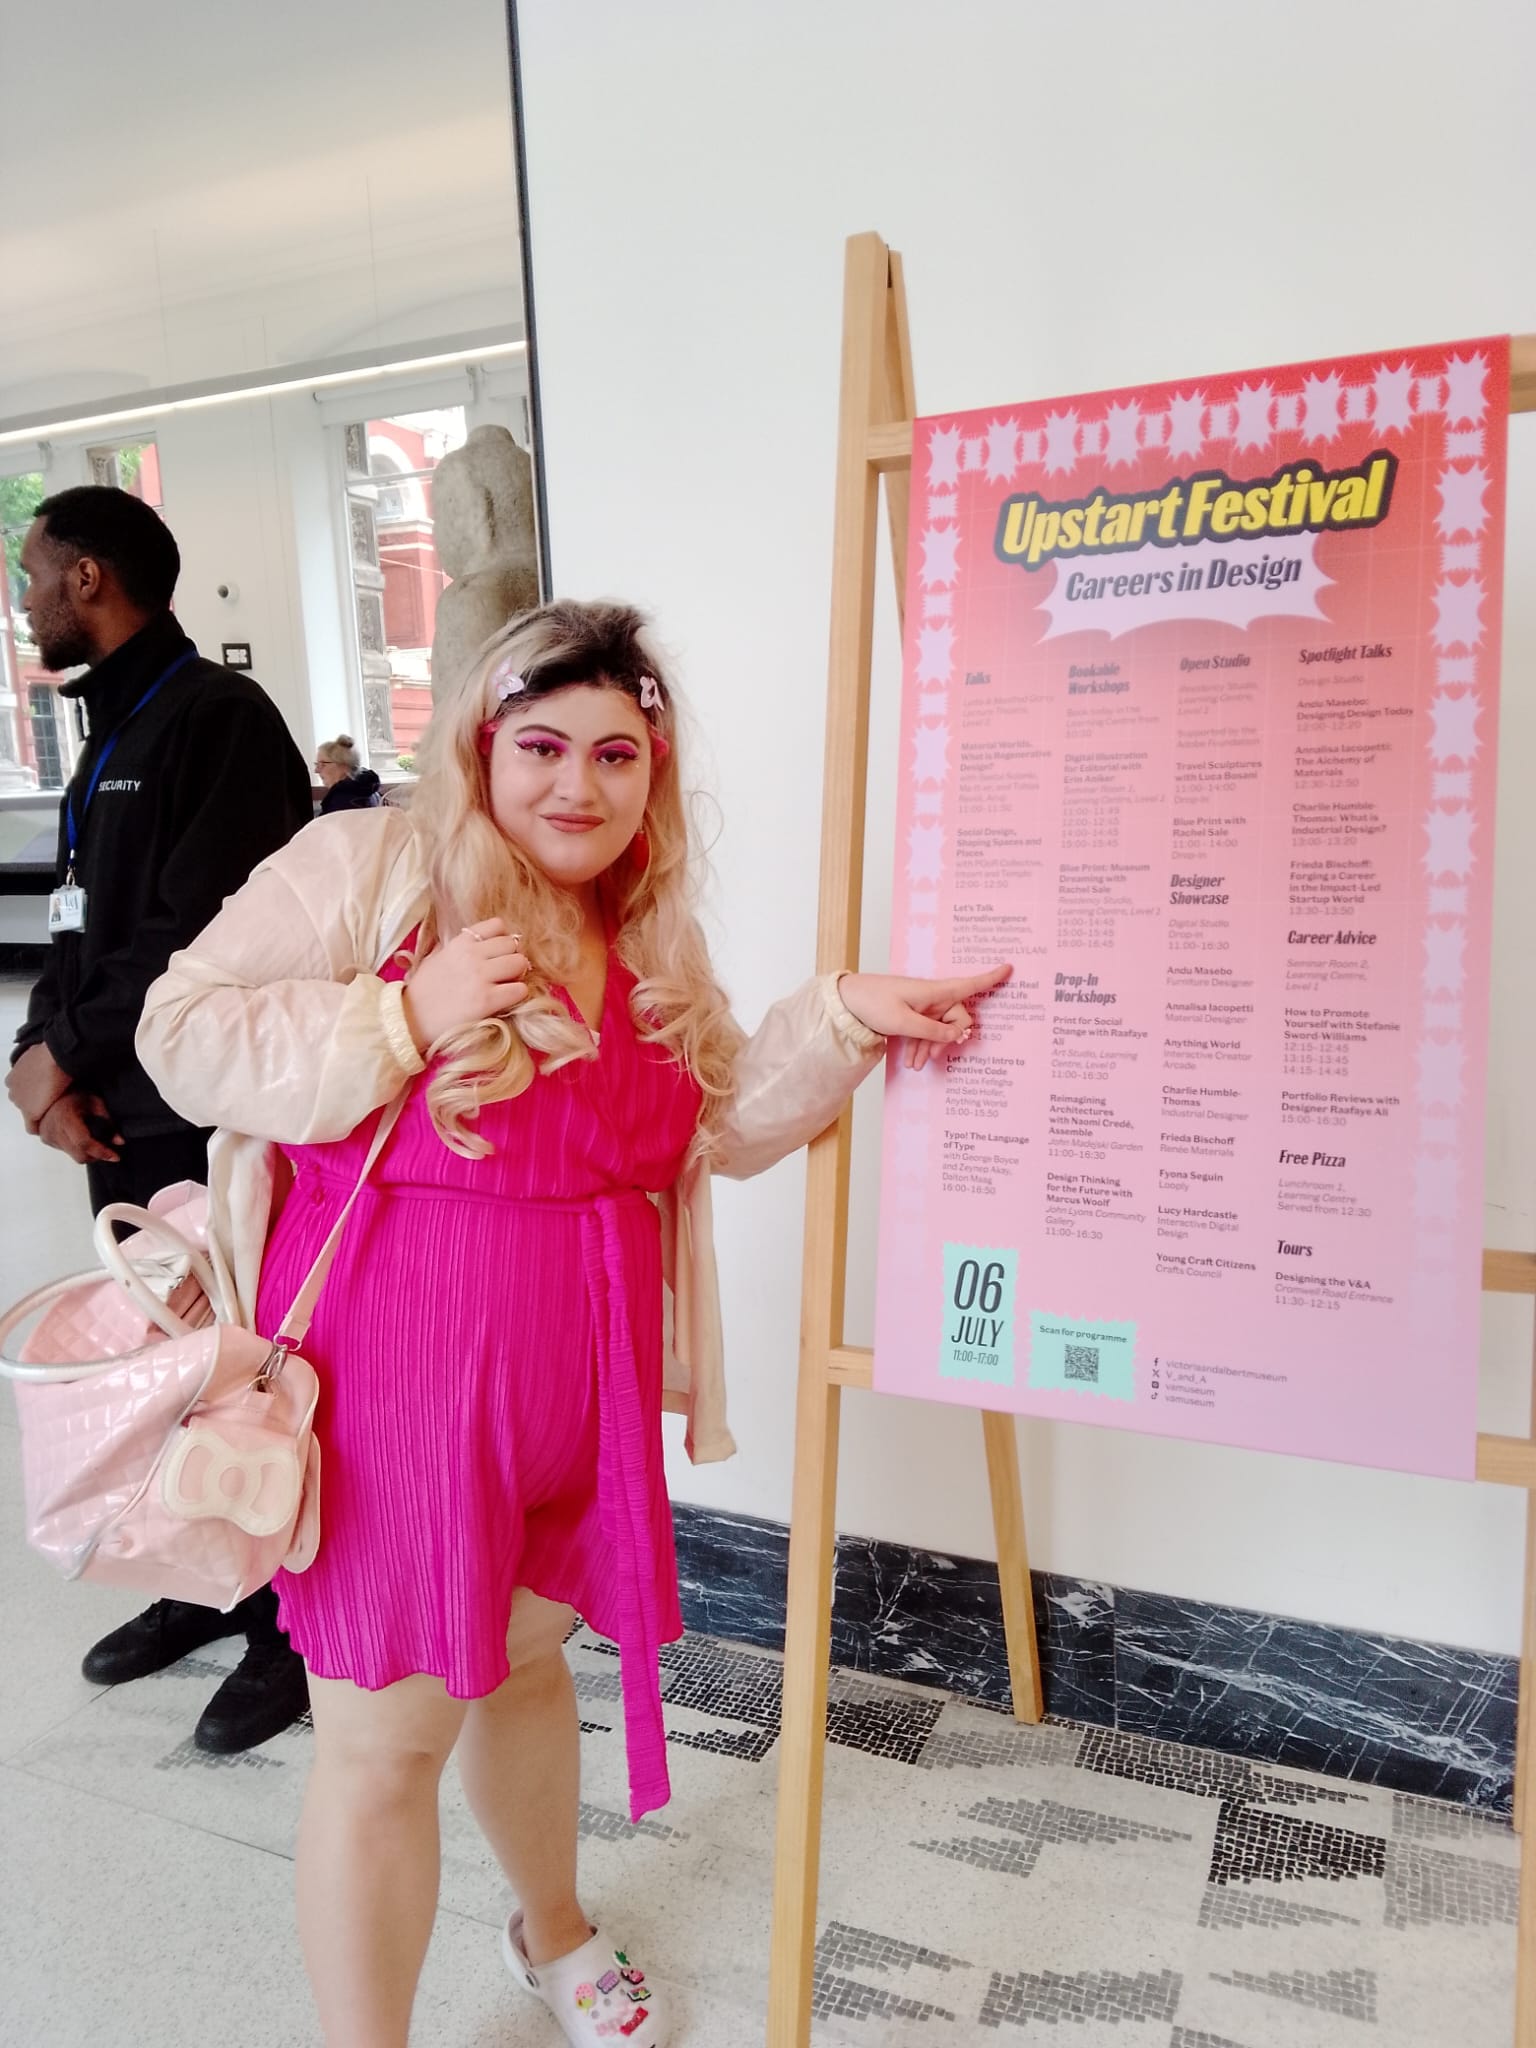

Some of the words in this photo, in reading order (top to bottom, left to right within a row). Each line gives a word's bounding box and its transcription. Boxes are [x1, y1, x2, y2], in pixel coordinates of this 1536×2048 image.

[1002, 488, 1180, 563] Upstart
[1183, 460, 1388, 536] Festival
[1065, 569, 1172, 601] Careers
[1178, 562, 1200, 590] in
[1208, 556, 1302, 590] Design
[1298, 646, 1356, 664] Spotlight
[1359, 644, 1392, 658] Talks
[1180, 656, 1209, 672] Open
[1211, 654, 1249, 668] Studio
[1068, 662, 1120, 677] Bookable
[965, 671, 991, 685] Talks
[1068, 679, 1130, 697] Workshops
[1297, 710, 1345, 721] Designing
[1347, 708, 1380, 719] Design
[1385, 707, 1413, 717] Today
[1176, 761, 1205, 769] Travel
[1208, 760, 1262, 770] Sculptures
[98, 780, 141, 791] SECURITY
[1224, 816, 1246, 824] with
[1173, 828, 1205, 836] Rachel
[1291, 826, 1341, 834] Industrial
[1290, 860, 1322, 868] Frieda
[1059, 875, 1102, 884] Dreaming
[1170, 874, 1225, 889] Designer
[1290, 872, 1328, 881] Forging
[1320, 884, 1380, 893] Impact-Led
[1170, 891, 1229, 904] Showcase
[1289, 895, 1329, 904] Startup
[1288, 930, 1333, 943] Career
[1335, 931, 1376, 944] Advice
[1054, 972, 1098, 988] Drop-In
[1054, 989, 1116, 1005] Workshops
[1166, 1002, 1206, 1010] Annalisa
[1209, 1004, 1253, 1014] Iacopetti
[1285, 1008, 1307, 1016] How
[1323, 1009, 1369, 1018] Promote
[1094, 1017, 1122, 1025] Social
[1284, 1019, 1327, 1028] Yourself
[1330, 1021, 1353, 1029] with
[1355, 1022, 1399, 1030] Stefanie
[1053, 1027, 1086, 1037] Change
[1088, 1028, 1108, 1036] with
[1110, 1029, 1147, 1039] Raafaye
[1284, 1031, 1366, 1041] Sword-Williams
[1164, 1038, 1207, 1049] Anything
[1210, 1040, 1240, 1048] World
[992, 1057, 1014, 1065] Intro
[946, 1065, 982, 1073] Creative
[984, 1067, 1006, 1075] Code
[1162, 1085, 1197, 1094] Charlie
[1050, 1094, 1106, 1106] Reimagining
[1162, 1097, 1200, 1106] Thomas
[1281, 1091, 1327, 1101] Portfolio
[1330, 1094, 1373, 1103] Reviews
[1375, 1096, 1399, 1104] with
[1050, 1105, 1113, 1115] Architectures
[1281, 1103, 1327, 1115] Designer
[1330, 1105, 1371, 1117] Raafaye
[1374, 1108, 1388, 1116] Ali
[1049, 1115, 1069, 1123] with
[1071, 1117, 1100, 1125] Naomi
[944, 1130, 967, 1140] Typo!
[971, 1132, 986, 1140] The
[988, 1133, 1029, 1145] Language
[1049, 1127, 1093, 1136] Assemble
[1160, 1133, 1191, 1142] Frieda
[1193, 1135, 1234, 1145] Bischoff
[954, 1141, 974, 1152] Type
[1279, 1149, 1308, 1164] Free
[1312, 1152, 1346, 1167] Pizza
[1047, 1172, 1077, 1183] Design
[1080, 1175, 1120, 1187] Thinking
[1159, 1169, 1187, 1180] Fyona
[1190, 1171, 1223, 1183] Seguin
[1047, 1183, 1062, 1191] for
[1062, 1184, 1076, 1192] the
[1079, 1186, 1109, 1195] Future
[1111, 1189, 1132, 1197] with
[1046, 1194, 1080, 1204] Marcus
[1082, 1197, 1109, 1206] Woolf
[1158, 1206, 1180, 1216] Lucy
[1183, 1208, 1237, 1219] Hardcastle
[1277, 1201, 1312, 1212] Served
[1314, 1204, 1338, 1214] from
[1277, 1240, 1312, 1256] Tours
[1157, 1253, 1185, 1264] Young
[1187, 1256, 1213, 1265] Craft
[1215, 1259, 1255, 1270] Citizens
[953, 1258, 1004, 1314] 06
[1275, 1271, 1326, 1286] Designing
[1328, 1277, 1345, 1286] the
[1347, 1279, 1371, 1289] V&A
[951, 1314, 1003, 1348] JULY
[1039, 1325, 1059, 1334] Scan
[1061, 1327, 1073, 1336] for
[1076, 1331, 1127, 1344] programme
